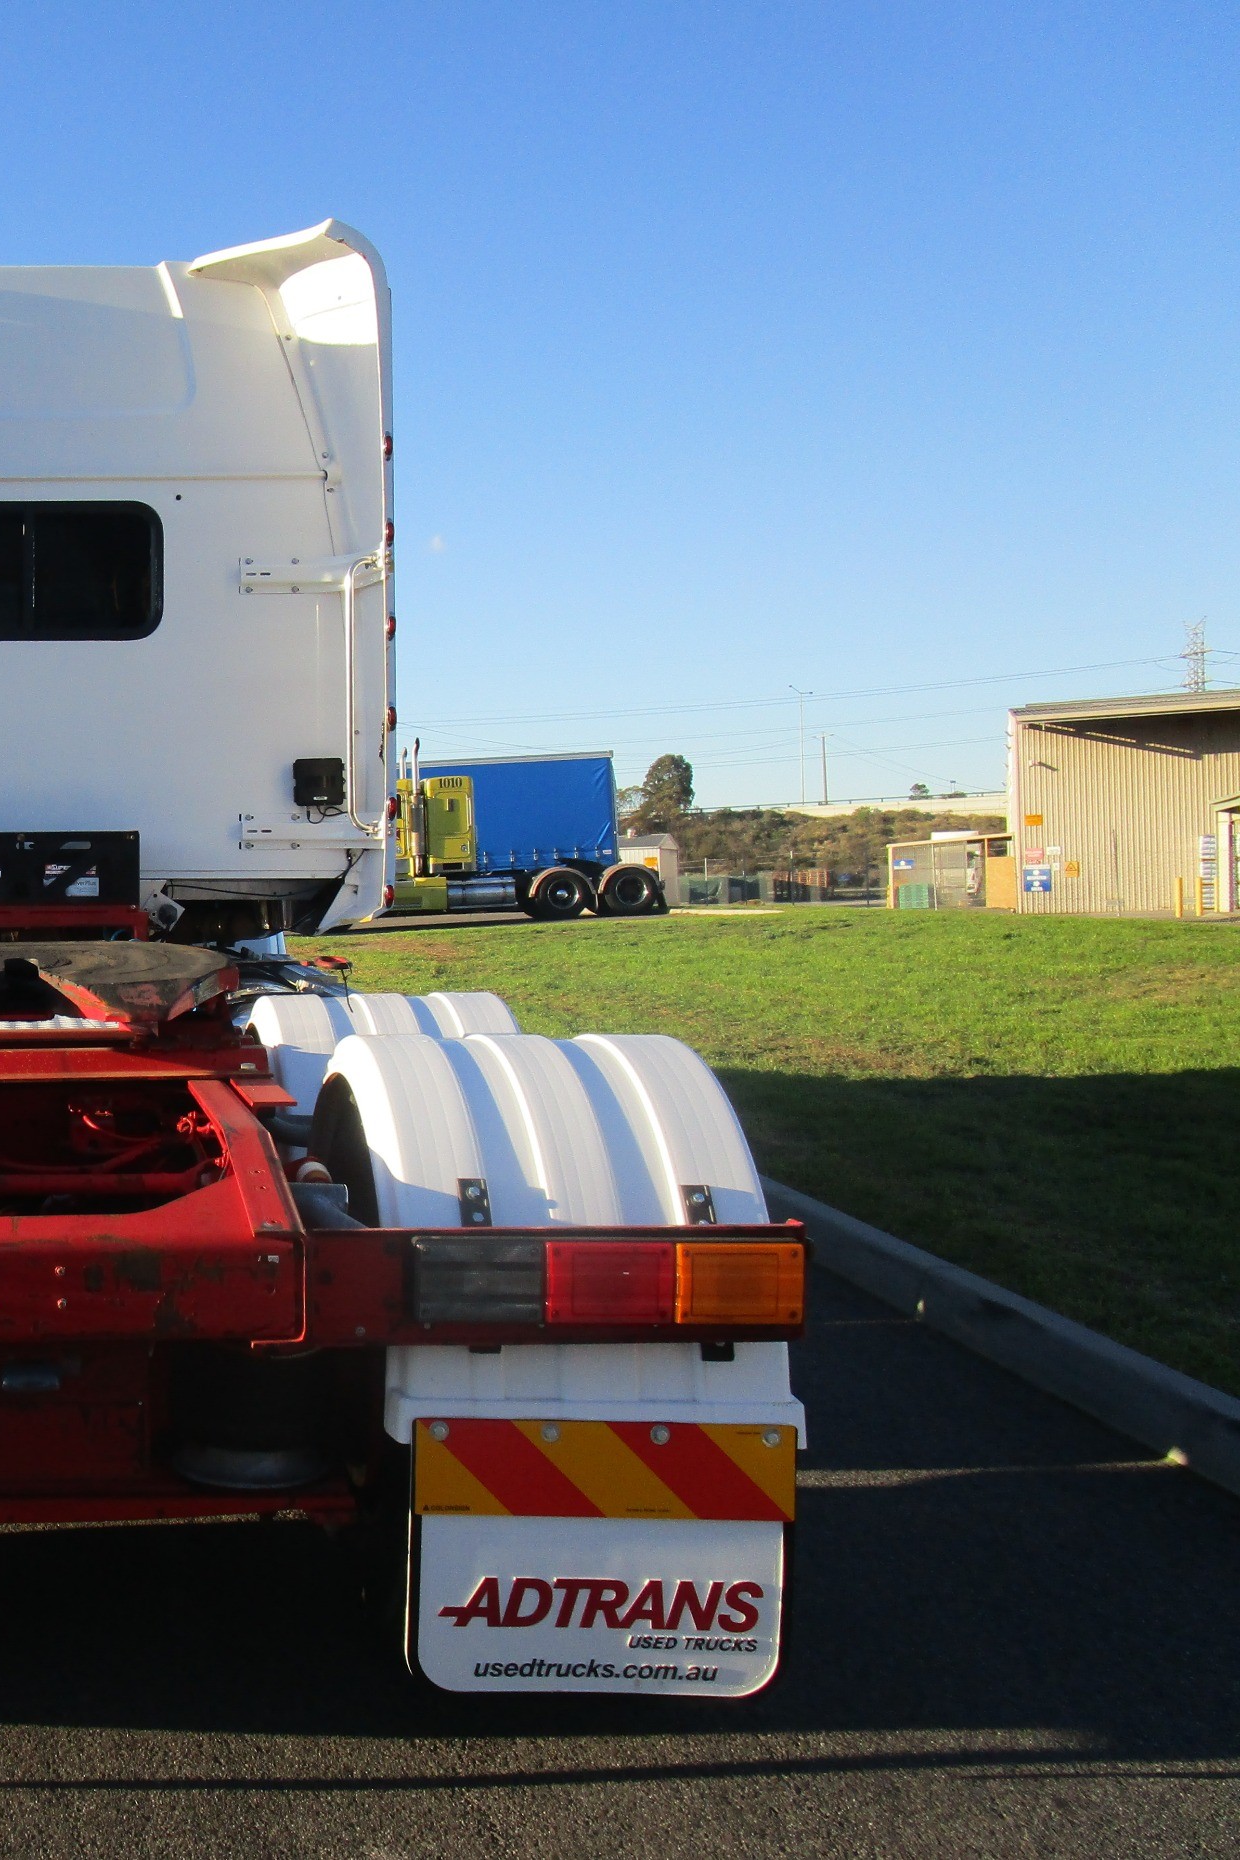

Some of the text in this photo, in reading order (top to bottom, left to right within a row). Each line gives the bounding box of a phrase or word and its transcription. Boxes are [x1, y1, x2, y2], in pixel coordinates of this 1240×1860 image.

[439, 777, 463, 788] 1010
[438, 1576, 764, 1632] ADTRANS
[628, 1635, 758, 1652] USED TRUCKS
[473, 1658, 719, 1682] usedtrucks.com.au
